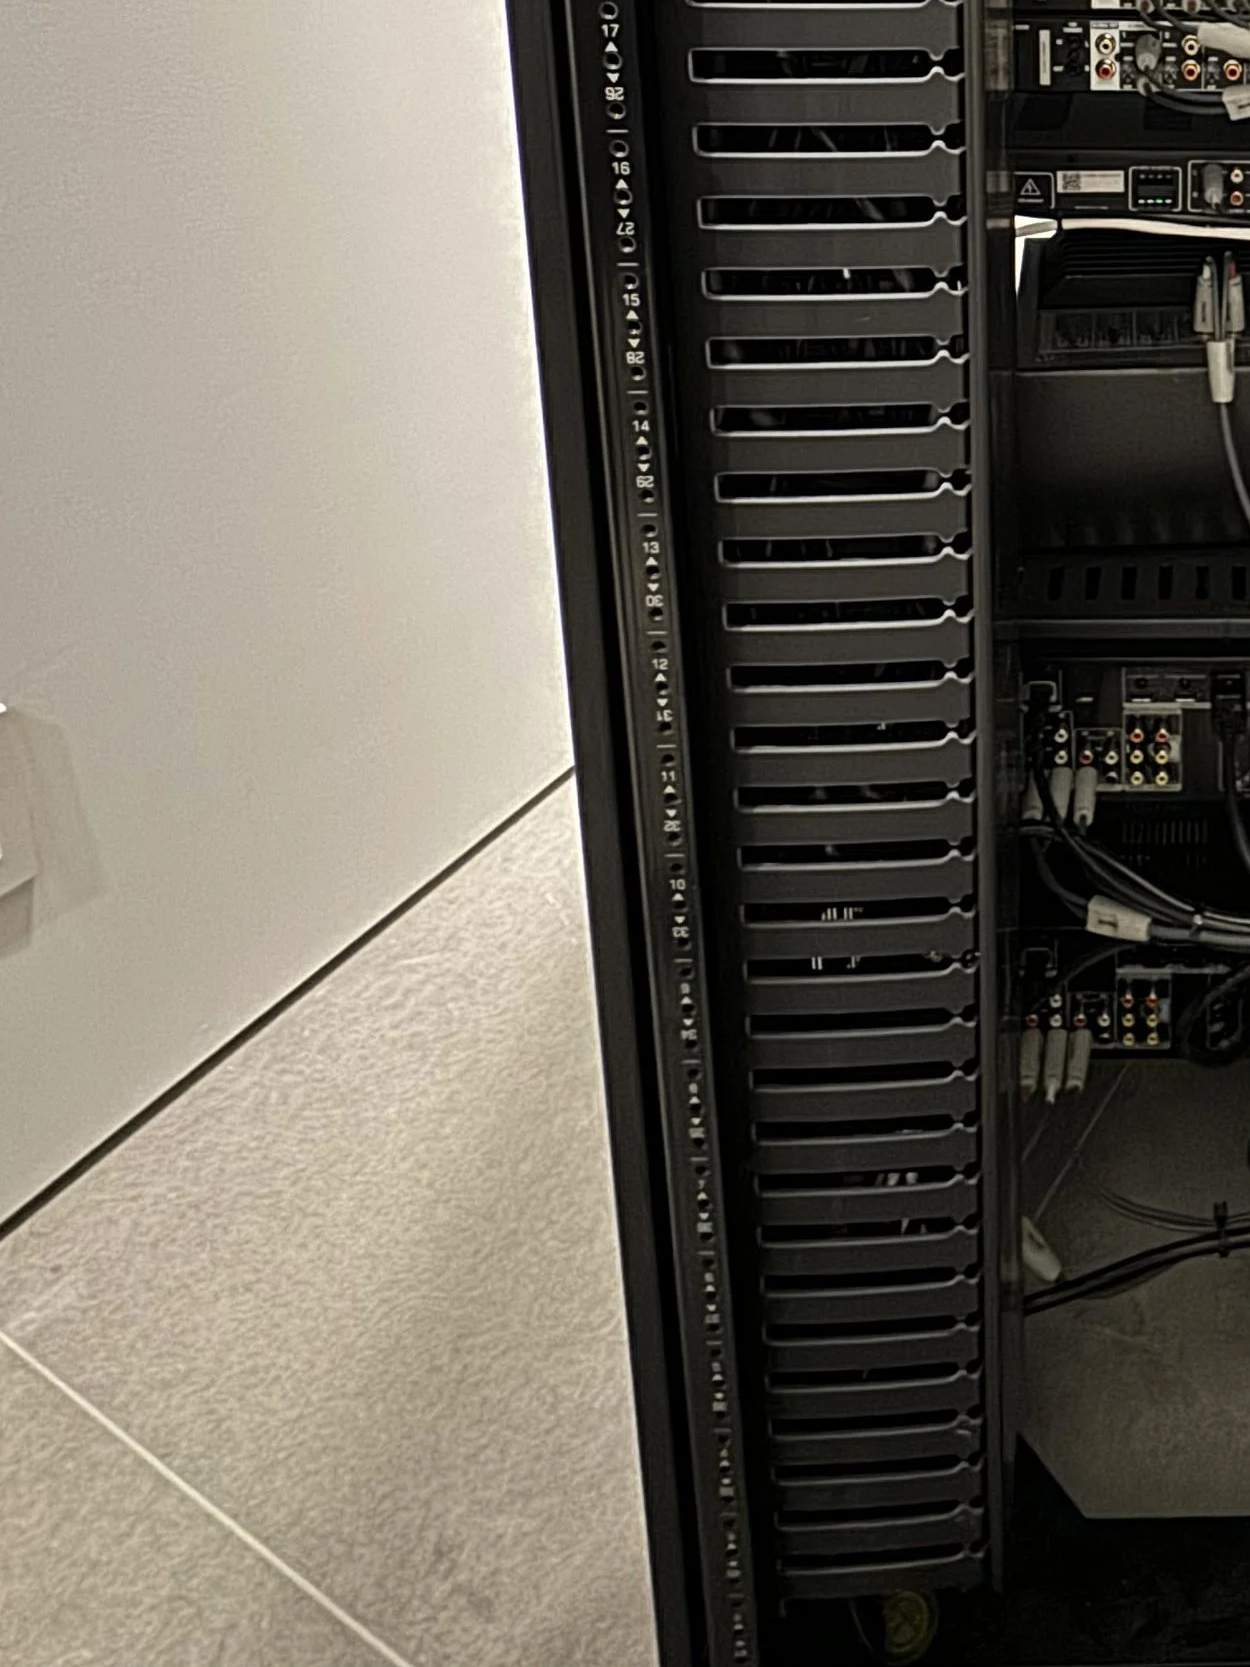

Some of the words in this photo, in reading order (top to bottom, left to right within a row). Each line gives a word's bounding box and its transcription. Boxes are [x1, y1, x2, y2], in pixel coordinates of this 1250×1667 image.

[602, 24, 619, 38] 17
[612, 162, 630, 175] 16
[623, 294, 640, 307] 15
[632, 420, 650, 432] 14
[643, 542, 660, 554] 13
[652, 659, 668, 670] 12
[661, 771, 675, 781] 11
